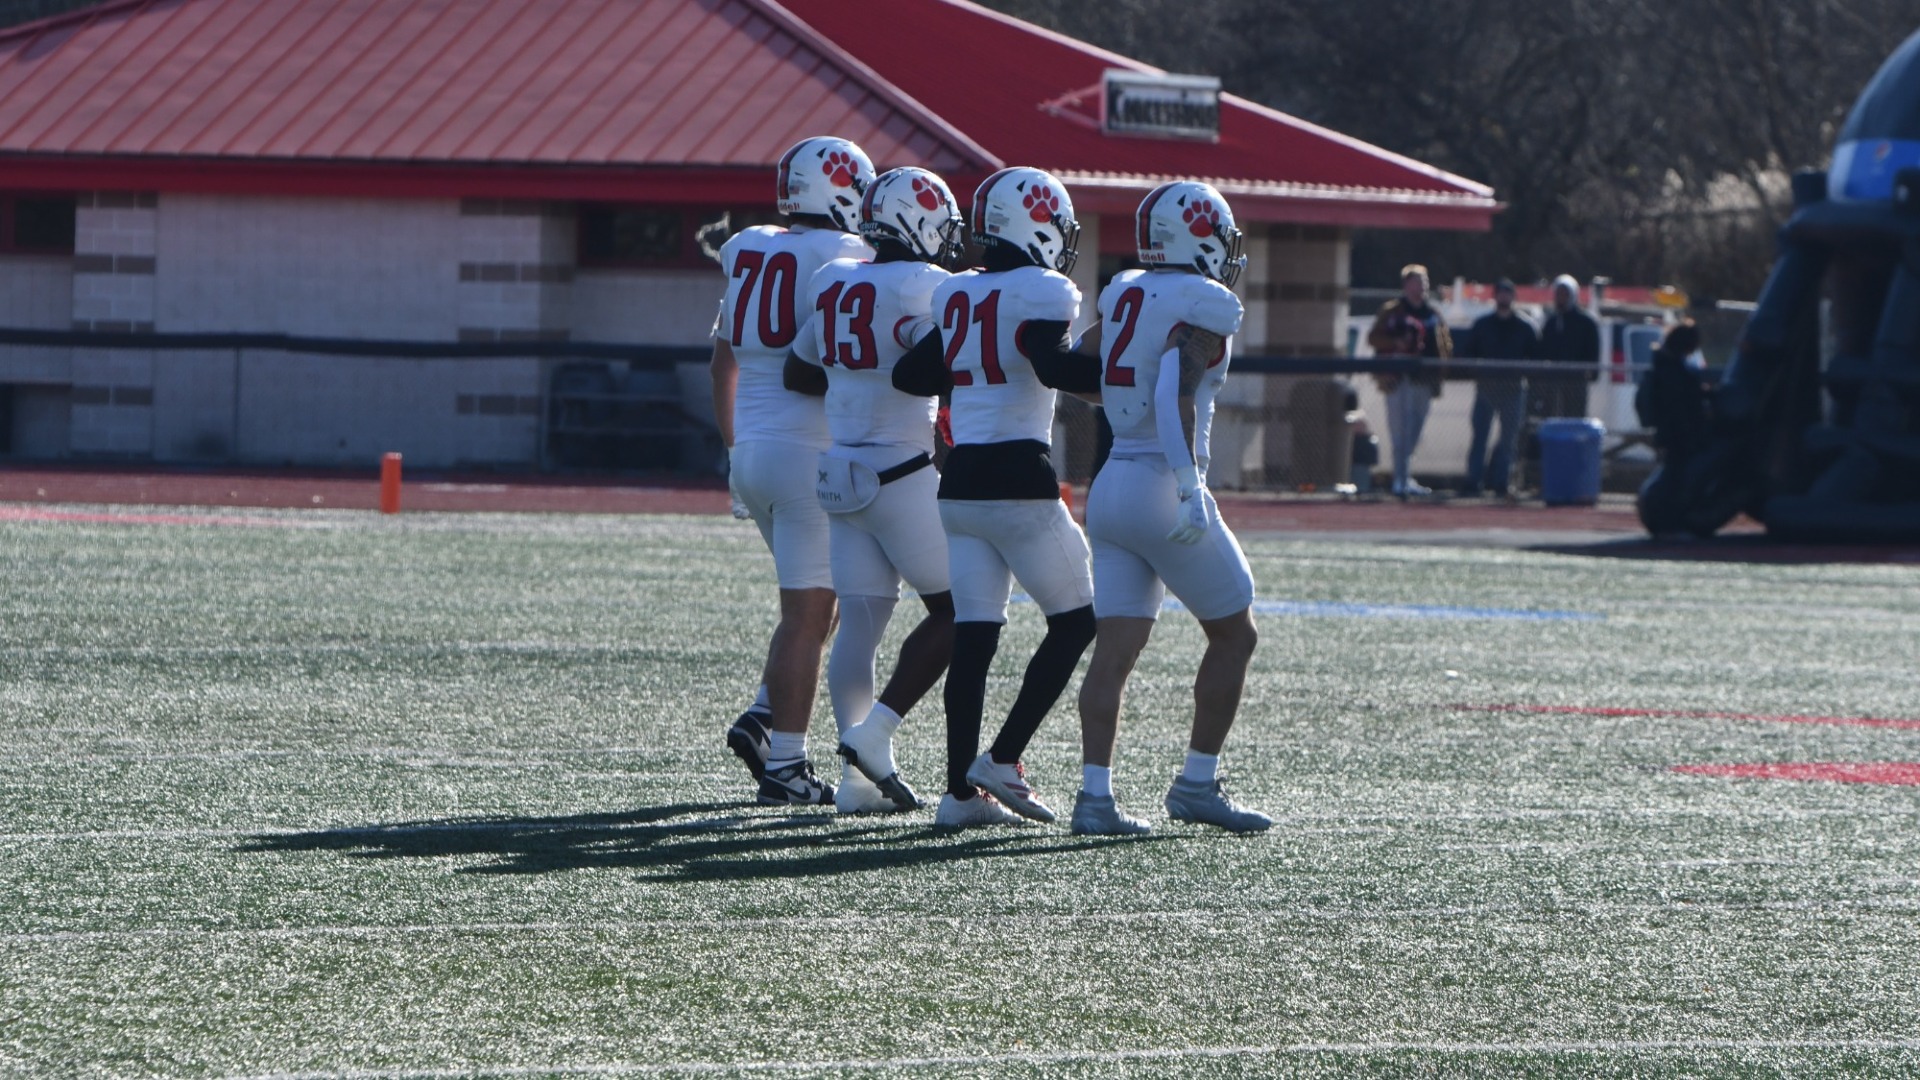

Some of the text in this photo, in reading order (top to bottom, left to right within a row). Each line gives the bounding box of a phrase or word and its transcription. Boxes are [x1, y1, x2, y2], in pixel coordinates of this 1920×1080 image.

[732, 249, 797, 348] 70
[816, 281, 878, 369] 13
[943, 289, 1006, 386] 21
[1104, 286, 1144, 387] 2
[816, 489, 842, 502] ENITH
